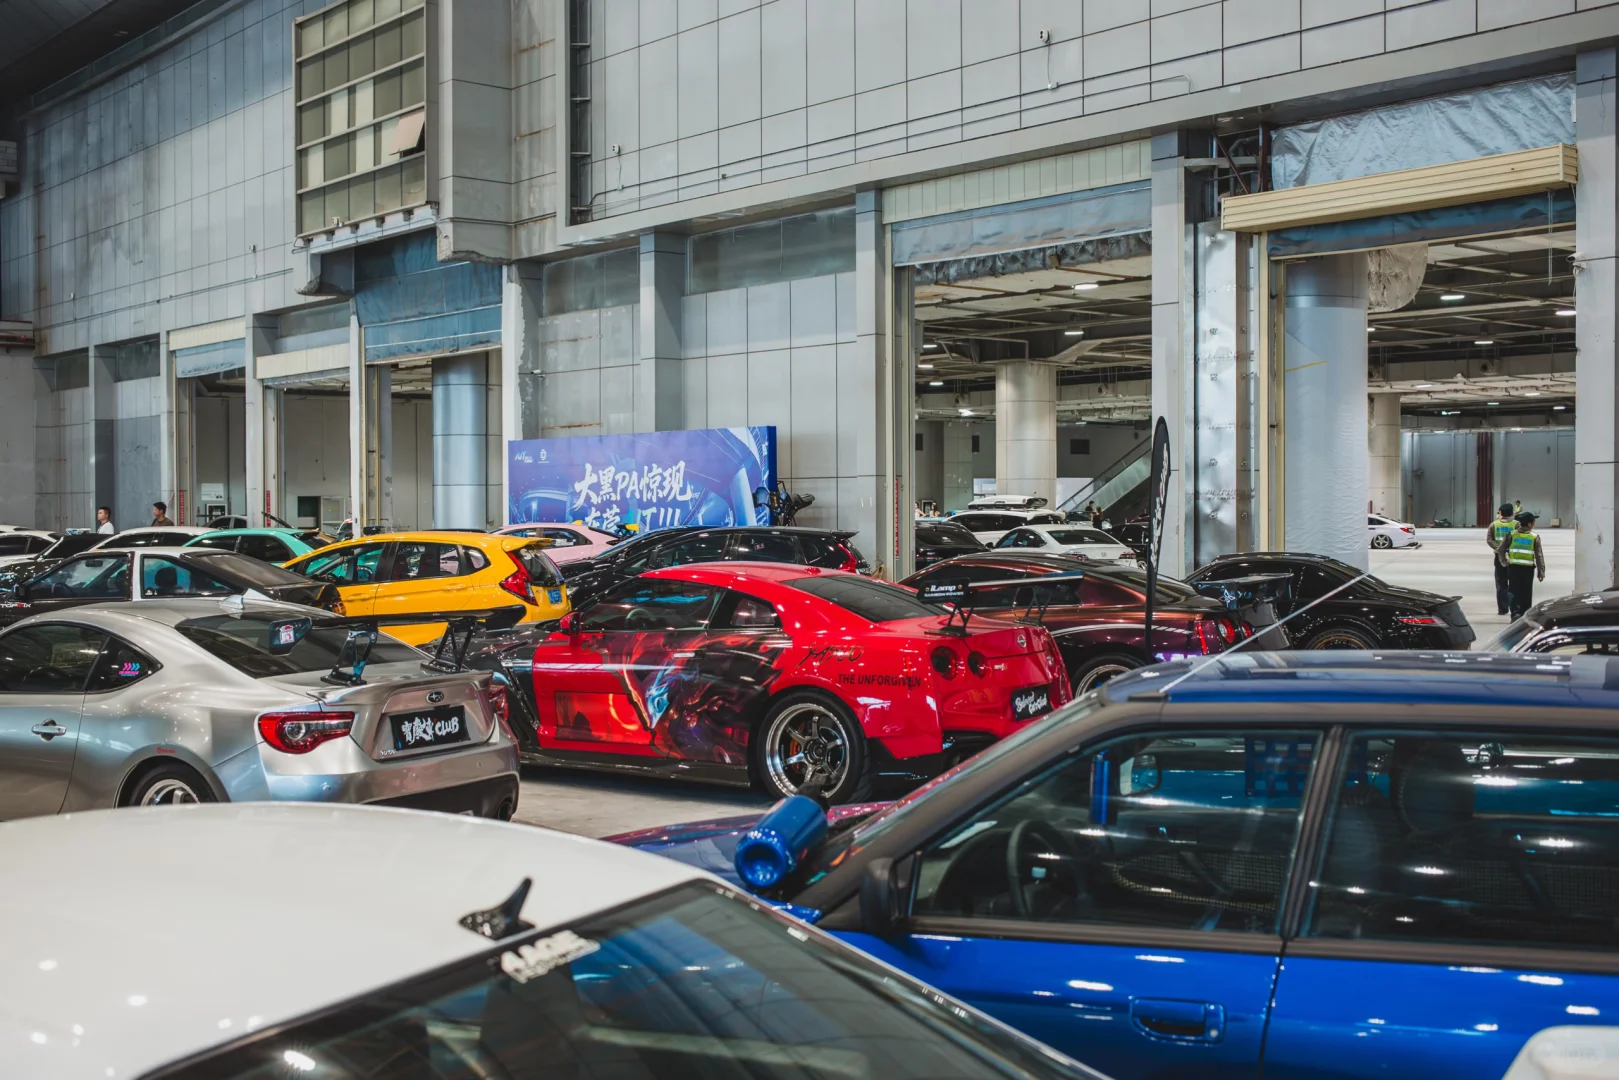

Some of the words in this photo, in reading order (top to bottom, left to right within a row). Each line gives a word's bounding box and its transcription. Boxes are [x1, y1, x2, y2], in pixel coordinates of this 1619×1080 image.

[573, 460, 692, 511] 大黑PA惊现
[838, 674, 856, 684] THE
[435, 717, 459, 735] CLUB
